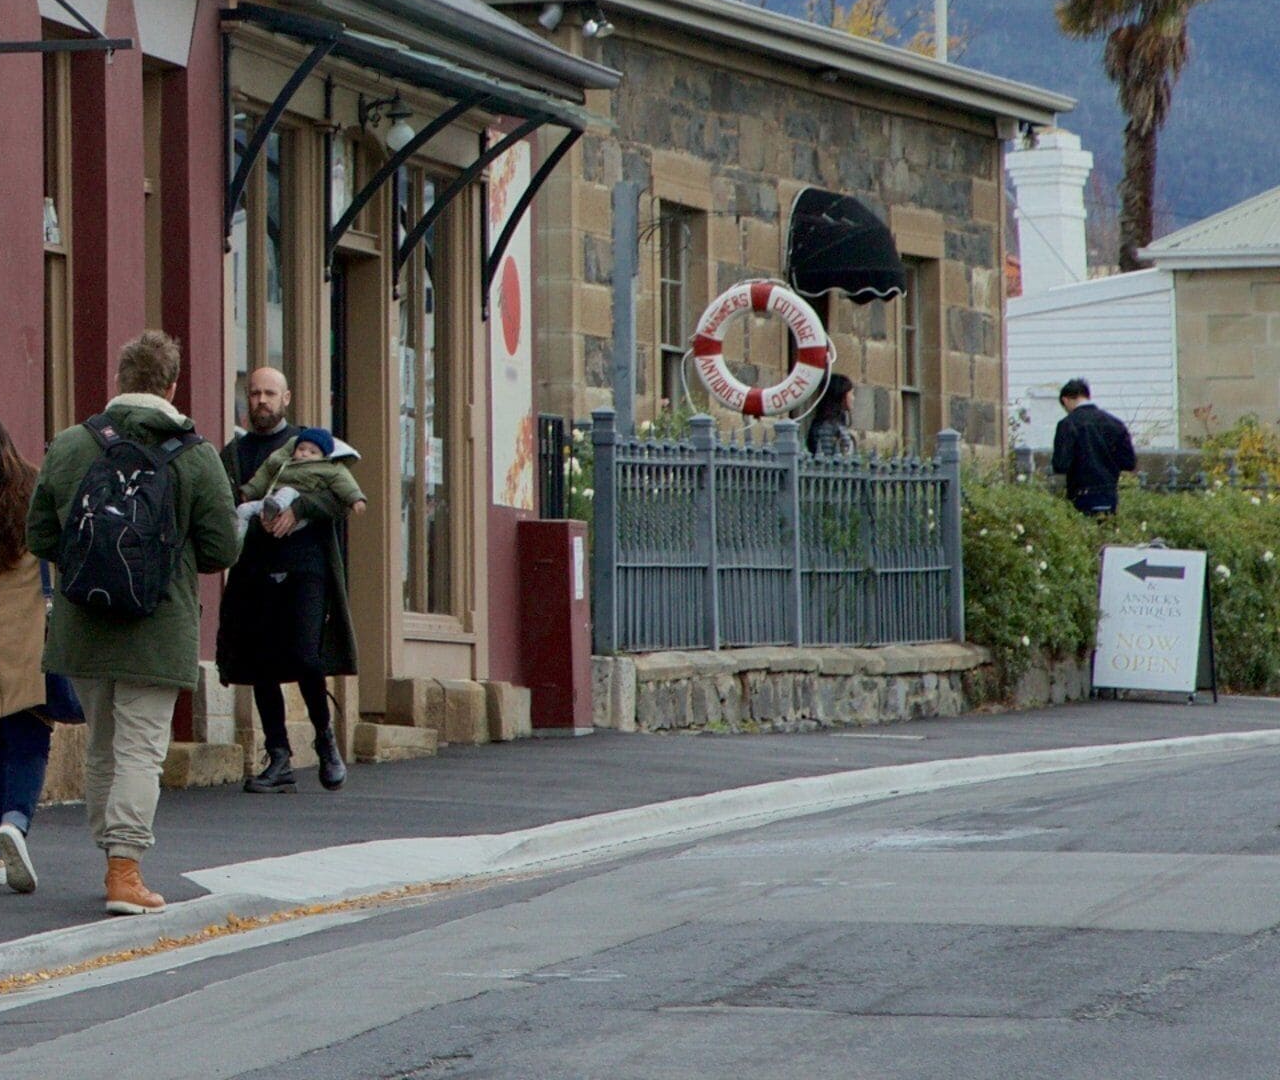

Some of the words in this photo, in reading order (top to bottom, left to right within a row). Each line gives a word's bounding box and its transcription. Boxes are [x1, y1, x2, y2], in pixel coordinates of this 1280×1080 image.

[773, 296, 816, 344] COTTAGE
[700, 358, 745, 408] ANTIQUES
[771, 375, 809, 409] OPEN
[1116, 632, 1180, 651] NOW
[1112, 653, 1179, 673] OPEN
